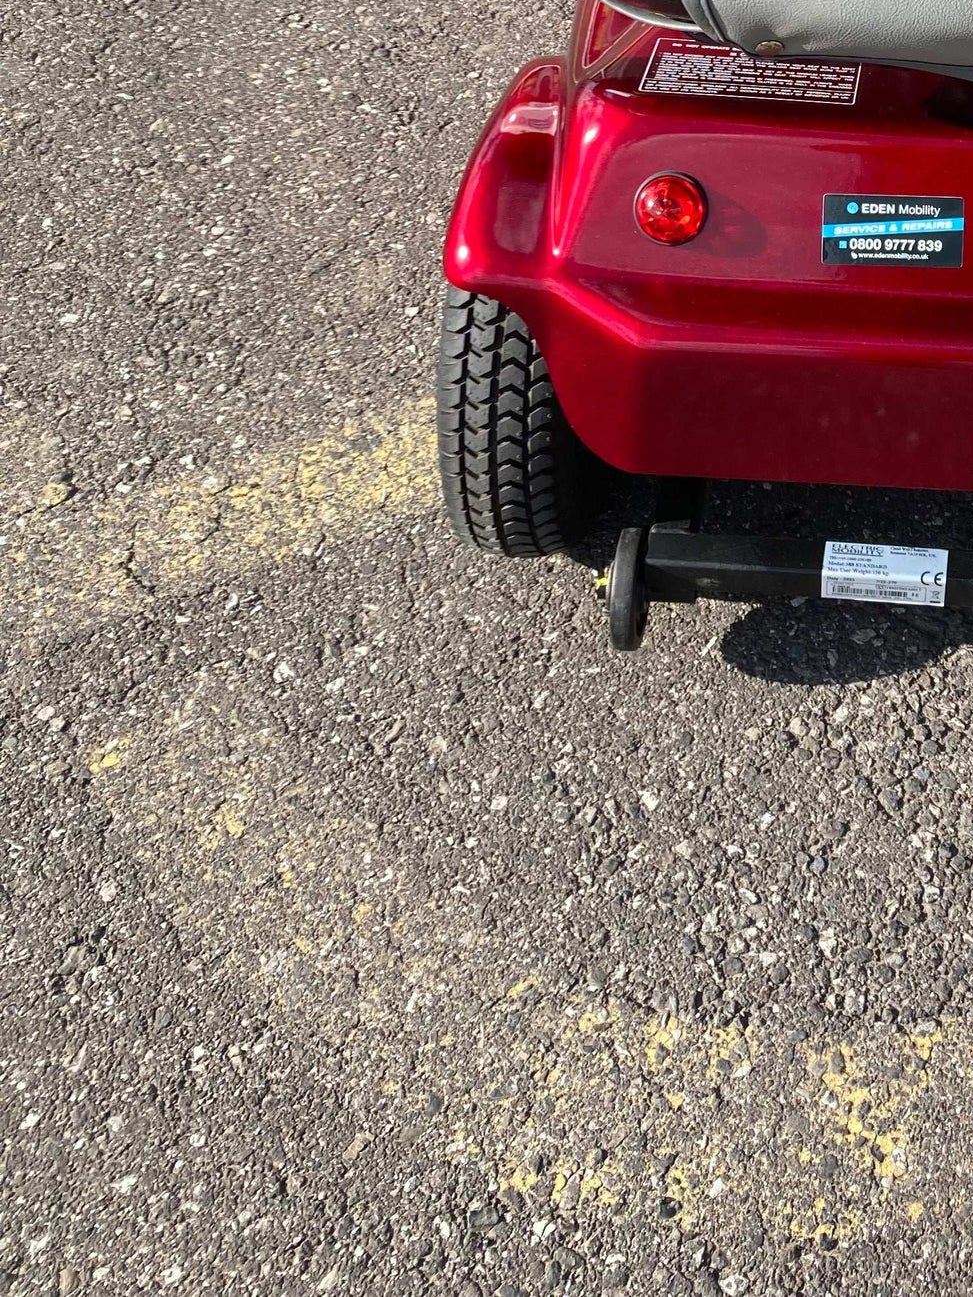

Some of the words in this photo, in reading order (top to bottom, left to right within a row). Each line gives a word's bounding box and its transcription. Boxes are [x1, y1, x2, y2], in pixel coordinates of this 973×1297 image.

[861, 203, 896, 215] EDEN
[898, 204, 941, 217] Mobility
[834, 224, 885, 235] SERVICE
[889, 223, 898, 233] &
[901, 221, 953, 231] REPAIRS
[850, 238, 882, 251] 0800
[884, 239, 916, 252] 9777
[917, 240, 943, 252] 839
[920, 571, 944, 587] CE
